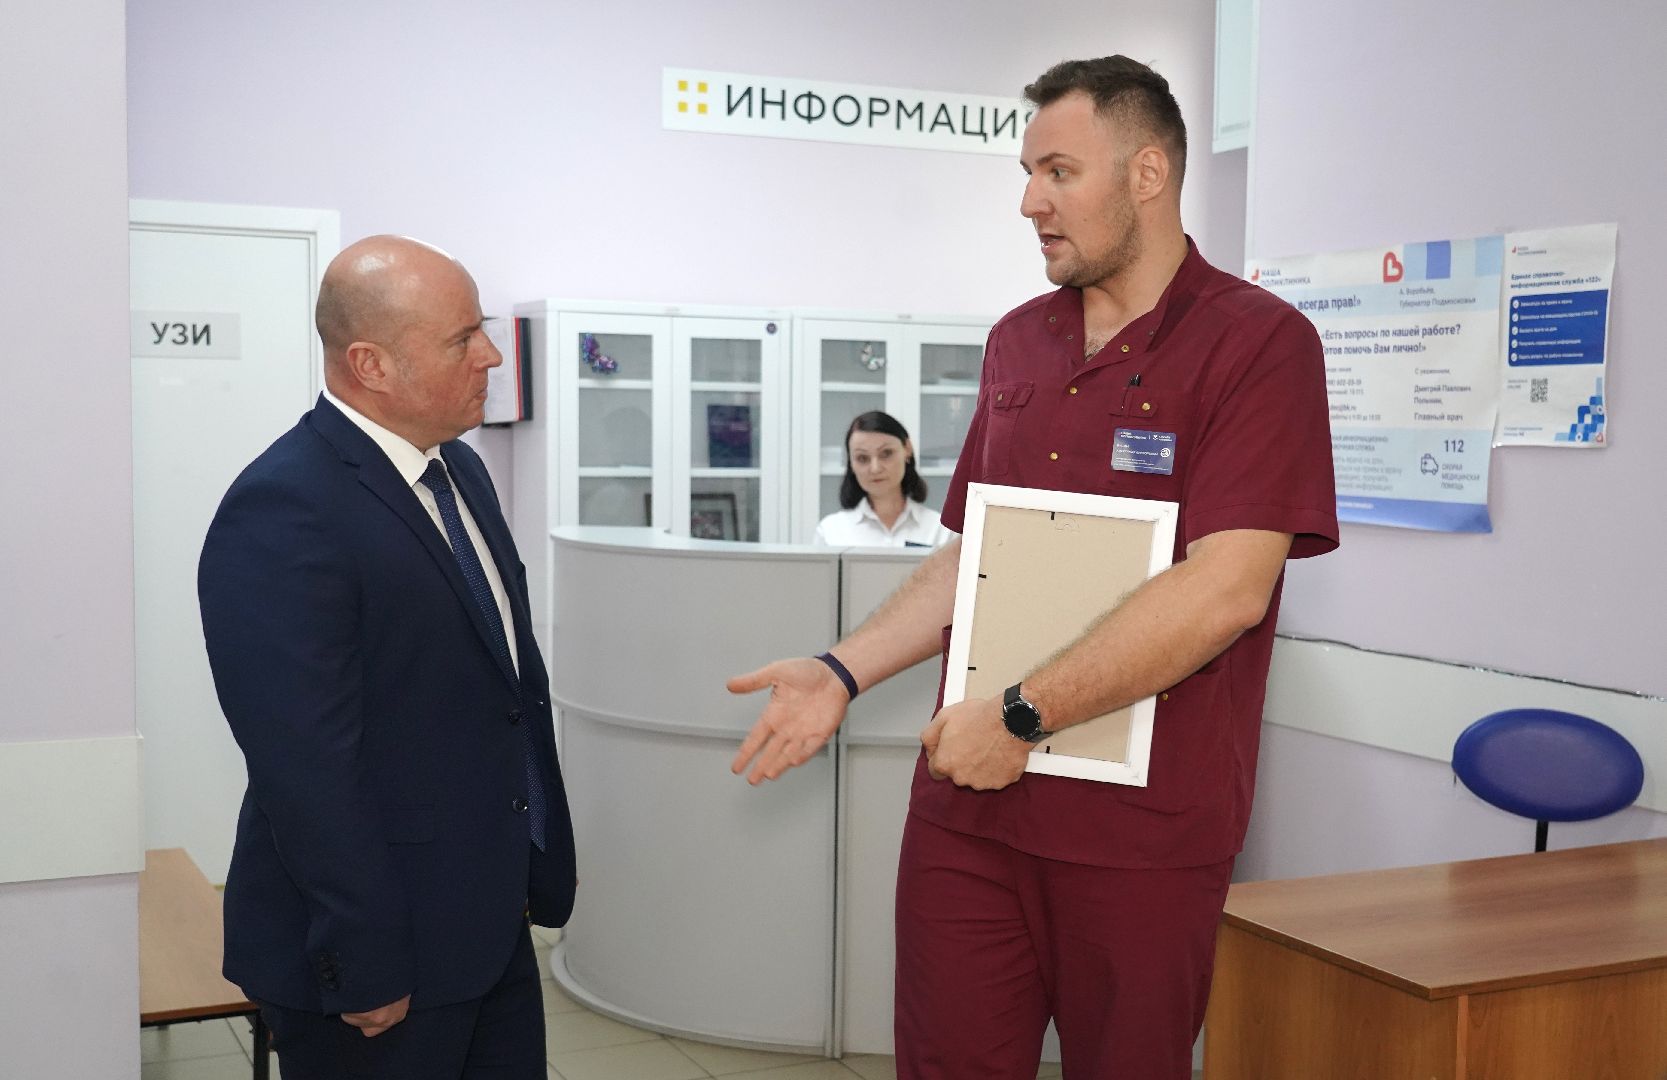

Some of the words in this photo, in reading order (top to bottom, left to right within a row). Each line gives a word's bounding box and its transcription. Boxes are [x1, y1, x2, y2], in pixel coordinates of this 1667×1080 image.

[1298, 298, 1329, 312] всегда
[1331, 294, 1362, 310] прав!»
[150, 321, 212, 346] УЗИ
[1344, 330, 1378, 342] вопросы
[1380, 329, 1390, 338] по
[1392, 325, 1420, 337] нашей
[1422, 324, 1461, 338] работе?
[1344, 346, 1372, 355] помочь
[1374, 343, 1390, 354] Вам
[1392, 342, 1426, 354] лично!»
[1414, 384, 1441, 393] Дмитрий
[1414, 412, 1445, 420] Главный
[1446, 414, 1464, 422] врач
[1444, 439, 1464, 453] 112
